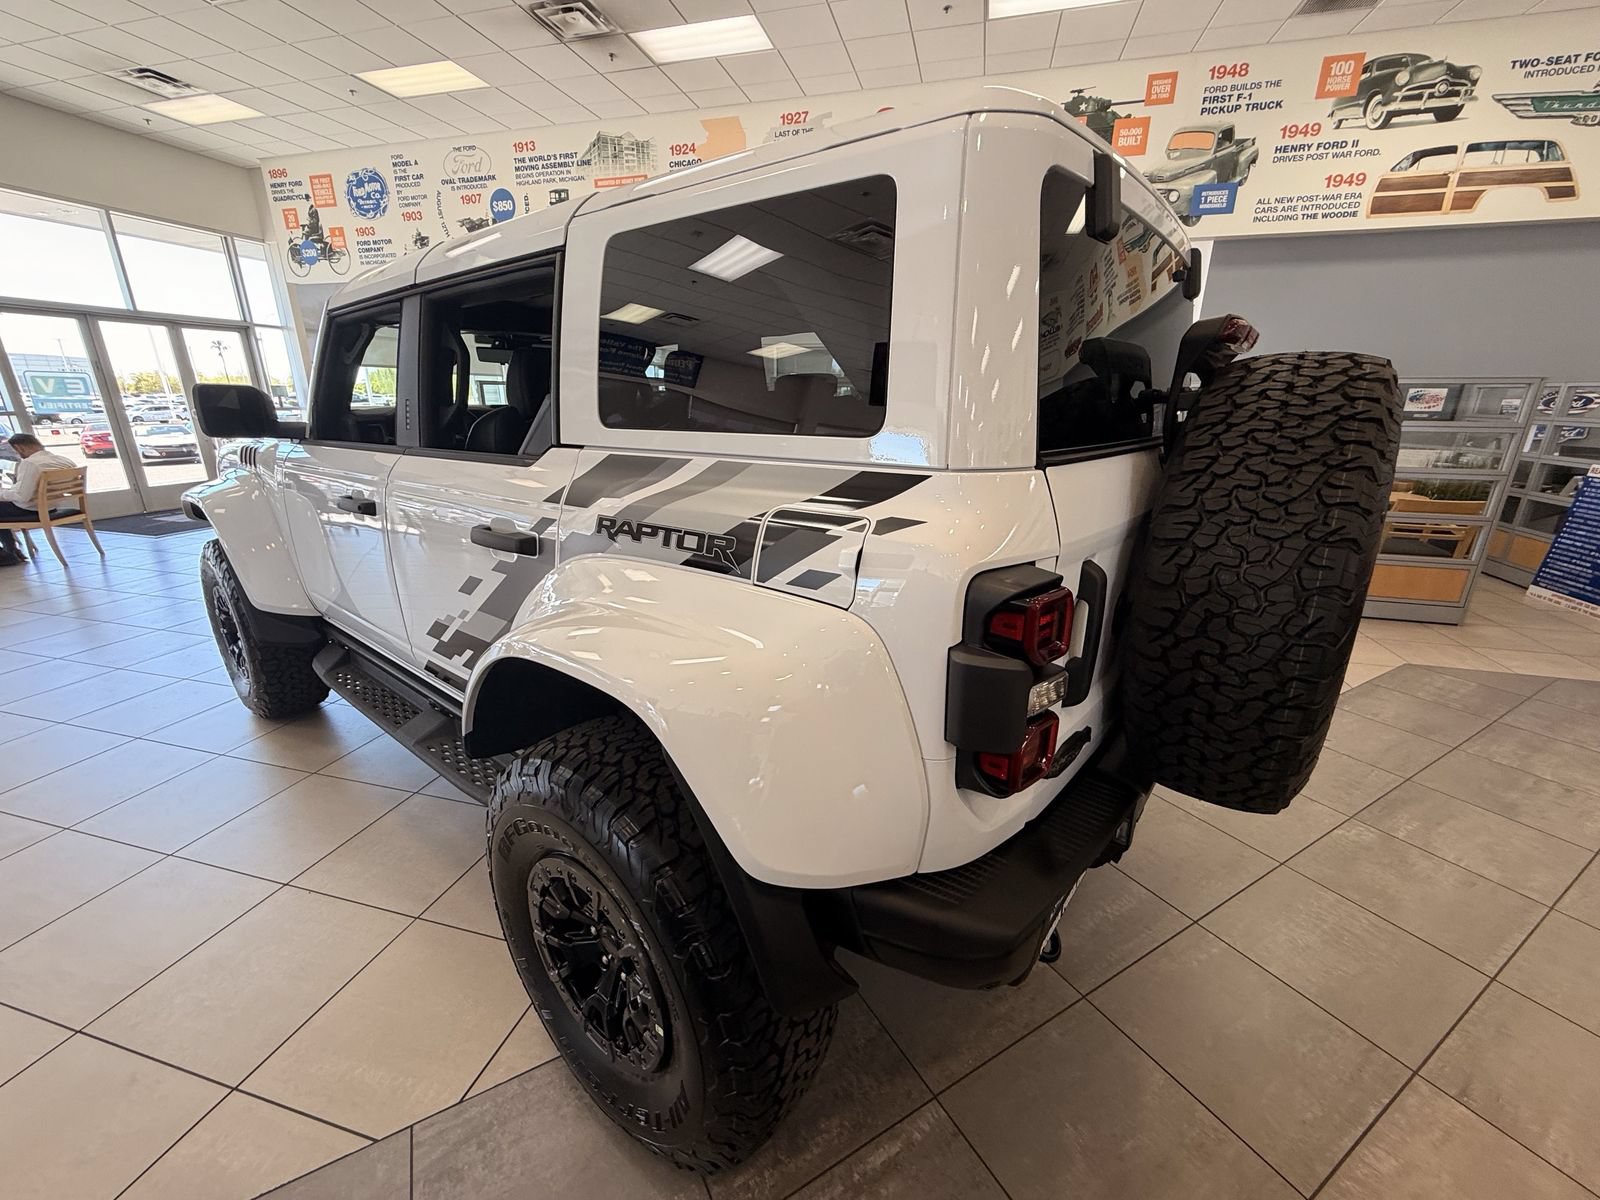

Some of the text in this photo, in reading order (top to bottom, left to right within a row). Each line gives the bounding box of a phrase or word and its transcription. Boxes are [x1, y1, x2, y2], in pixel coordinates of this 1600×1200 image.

[1330, 60, 1354, 76] 100
[1510, 54, 1582, 70] TWO-SEAT
[1209, 62, 1250, 80] 1948
[1524, 64, 1595, 78] INTRODUCED
[1152, 85, 1171, 94] OVER
[1204, 80, 1282, 94] FORD BUILDS THE
[1202, 93, 1252, 105] FIRST F-1
[1200, 100, 1283, 116] PICKUP TRUCK
[780, 111, 809, 125] 1927
[774, 130, 790, 138] LAST
[1280, 122, 1322, 139] 1949
[513, 140, 536, 153] 1913
[1118, 136, 1142, 147] BUILT
[1274, 140, 1359, 154] HENRY FORD II
[669, 142, 697, 156] 1924
[528, 154, 557, 163] WORLD'S
[1272, 149, 1381, 164] DRIVES POST WAR FORD.
[392, 160, 413, 168] MODEL
[452, 154, 483, 175] Ford
[514, 164, 540, 172] MOVING
[541, 161, 575, 170] ASSEMBLY
[669, 158, 702, 168] CHICAGO
[268, 168, 288, 179] 1896
[394, 174, 410, 182] FIRST
[458, 175, 496, 184] TRADEMARK
[535, 170, 564, 178] OPERATION
[1324, 172, 1367, 188] 1949
[460, 194, 482, 204] 1907
[1207, 195, 1228, 203] PIECE
[1274, 196, 1295, 204] NEW
[1296, 193, 1342, 203] POST-WAR
[1344, 192, 1362, 200] ERA
[436, 190, 444, 219] AUGUST
[492, 200, 513, 212] $850
[1254, 206, 1278, 214] CARS
[1300, 202, 1360, 212] INTRODUCED
[401, 211, 423, 222] 1903
[1253, 214, 1298, 223] INCLUDING
[1321, 210, 1358, 219] WOODIE
[355, 226, 375, 237] 1903
[358, 246, 384, 254] COMPANY
[596, 514, 740, 574] RAPTOR
